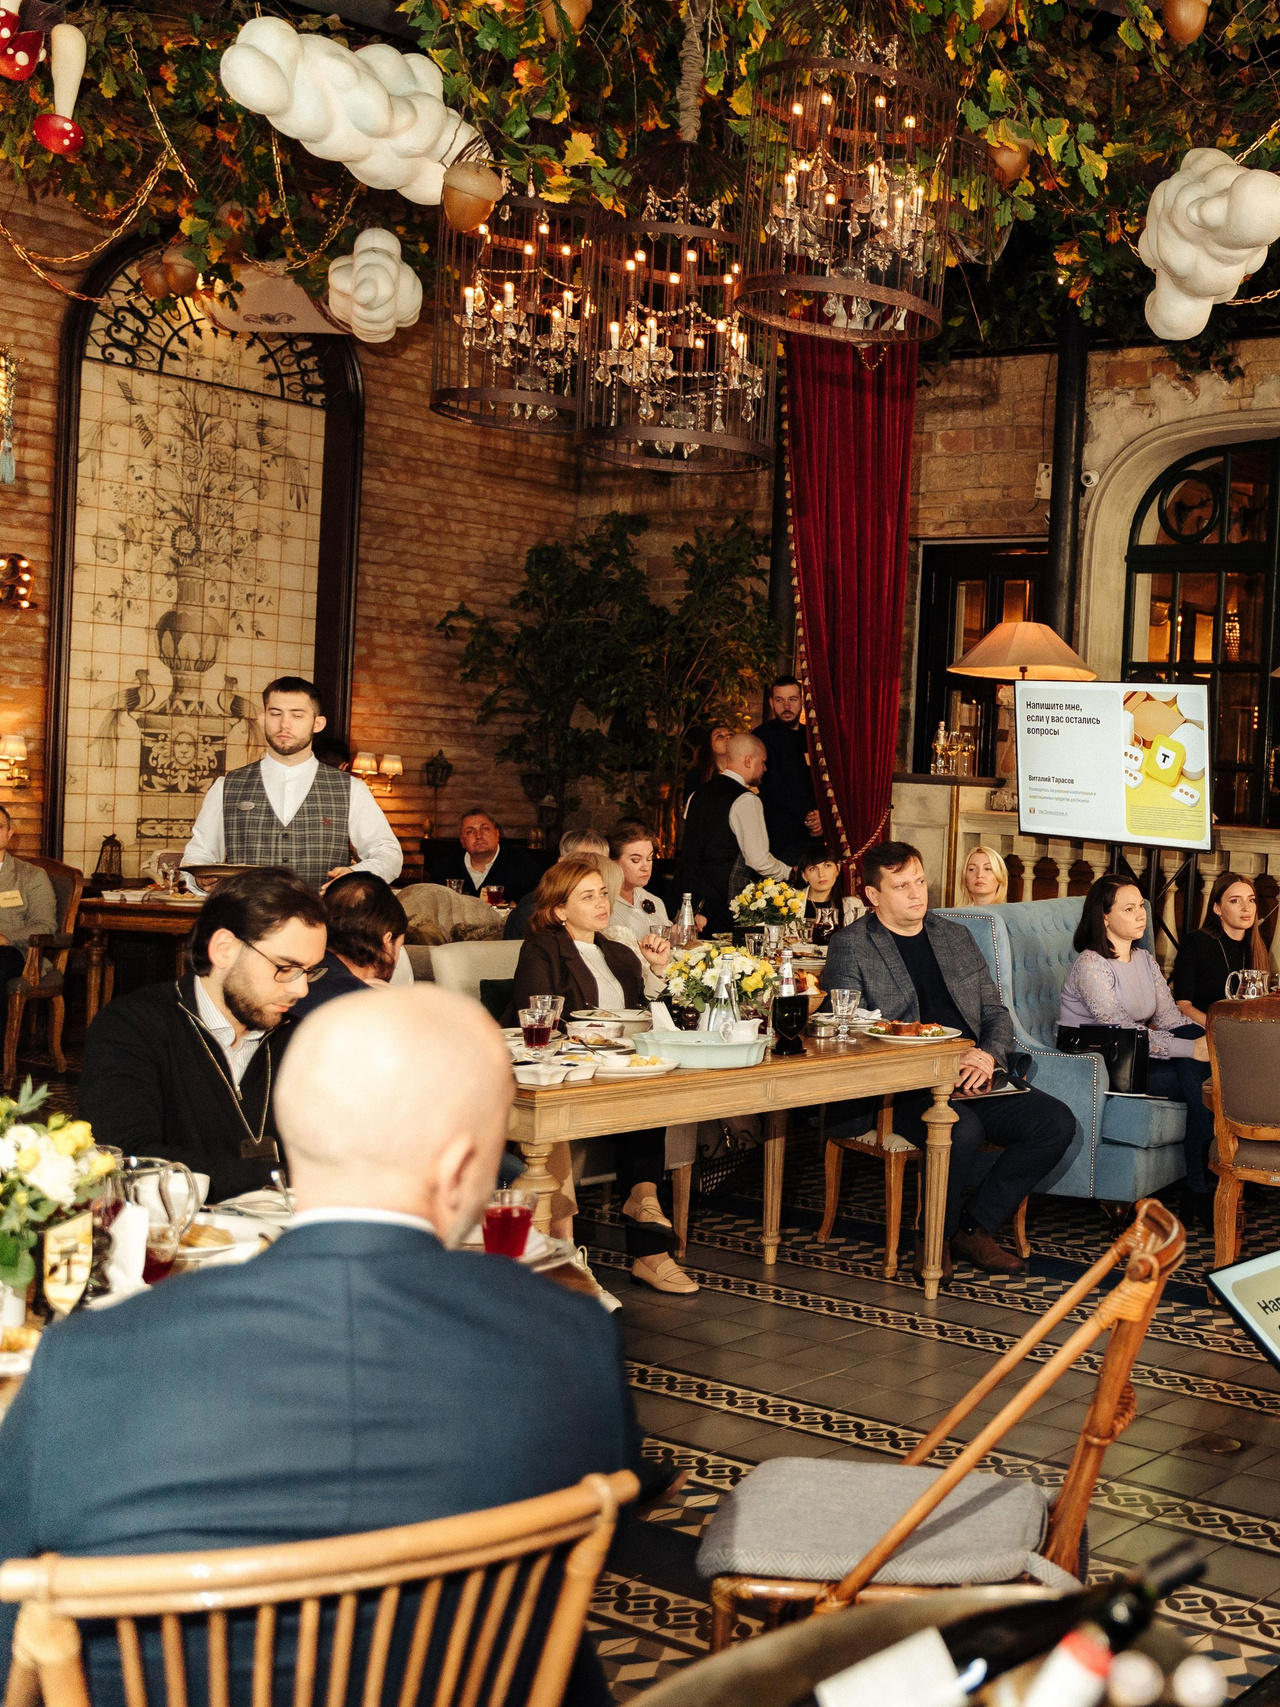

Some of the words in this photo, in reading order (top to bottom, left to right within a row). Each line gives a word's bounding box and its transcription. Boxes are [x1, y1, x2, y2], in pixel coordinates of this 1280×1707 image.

[1026, 700, 1064, 710] Напишите
[1065, 703, 1083, 712] мне,
[1026, 714, 1044, 722] если
[1045, 715, 1050, 724] у
[1051, 715, 1064, 723] вас
[1065, 716, 1101, 725] остались
[1026, 727, 1060, 736] вопросы
[1028, 774, 1051, 783] Виталий
[1052, 776, 1075, 784] Тарасов
